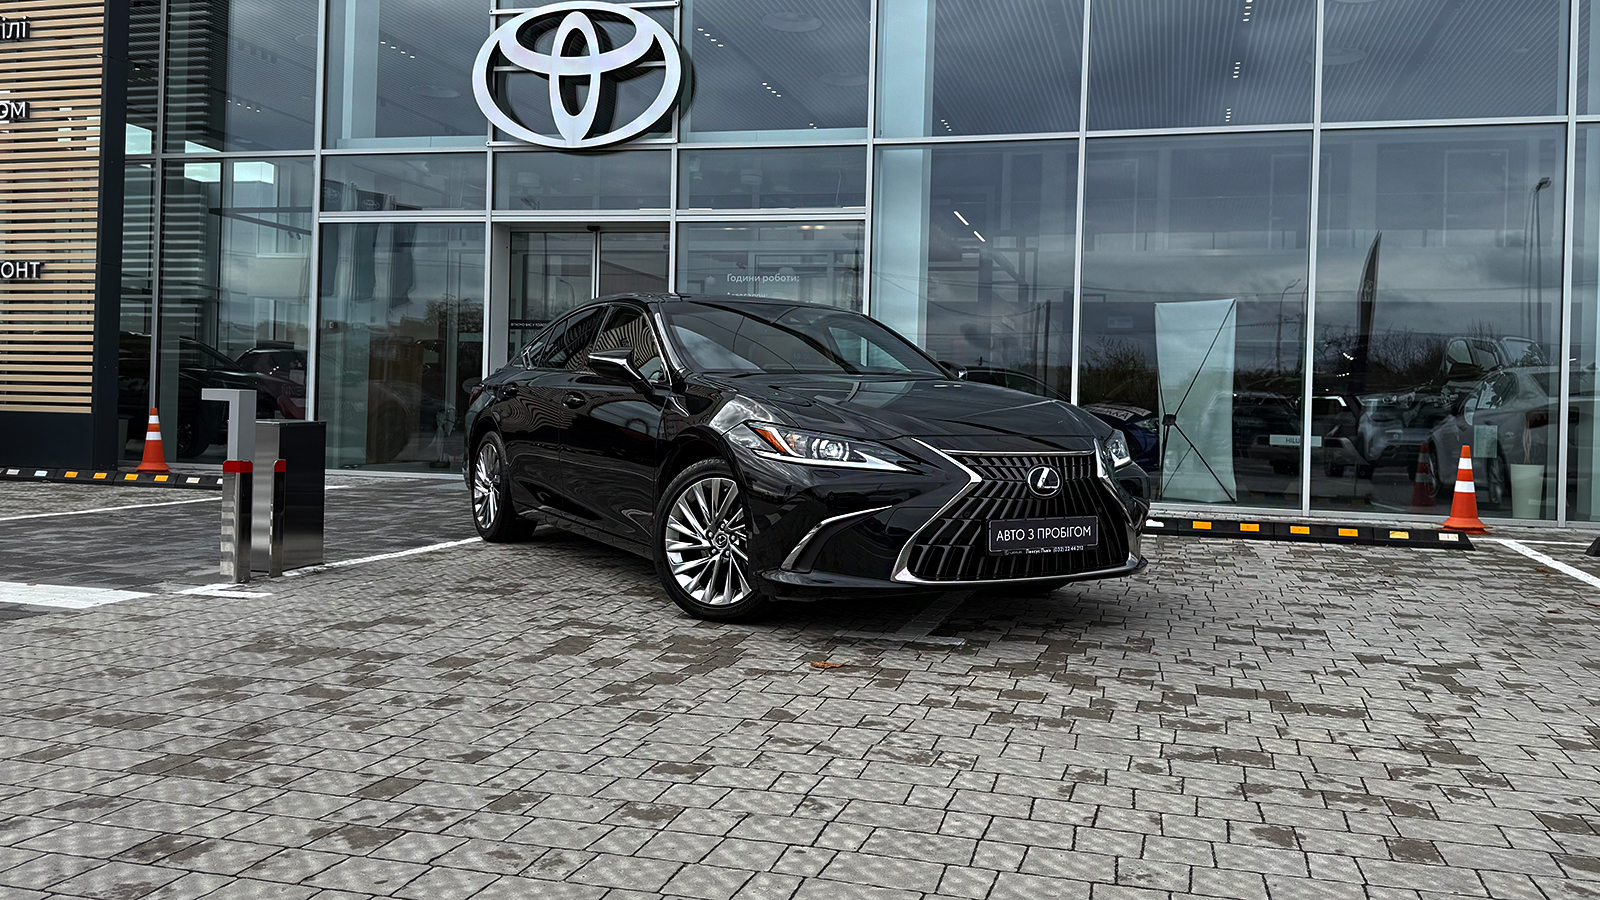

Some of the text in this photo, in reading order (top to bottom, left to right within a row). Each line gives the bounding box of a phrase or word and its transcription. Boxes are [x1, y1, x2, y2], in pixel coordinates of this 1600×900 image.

[726, 273, 800, 283] Години роботи:
[996, 525, 1091, 542] АВТО З ПРОБІГОМ
